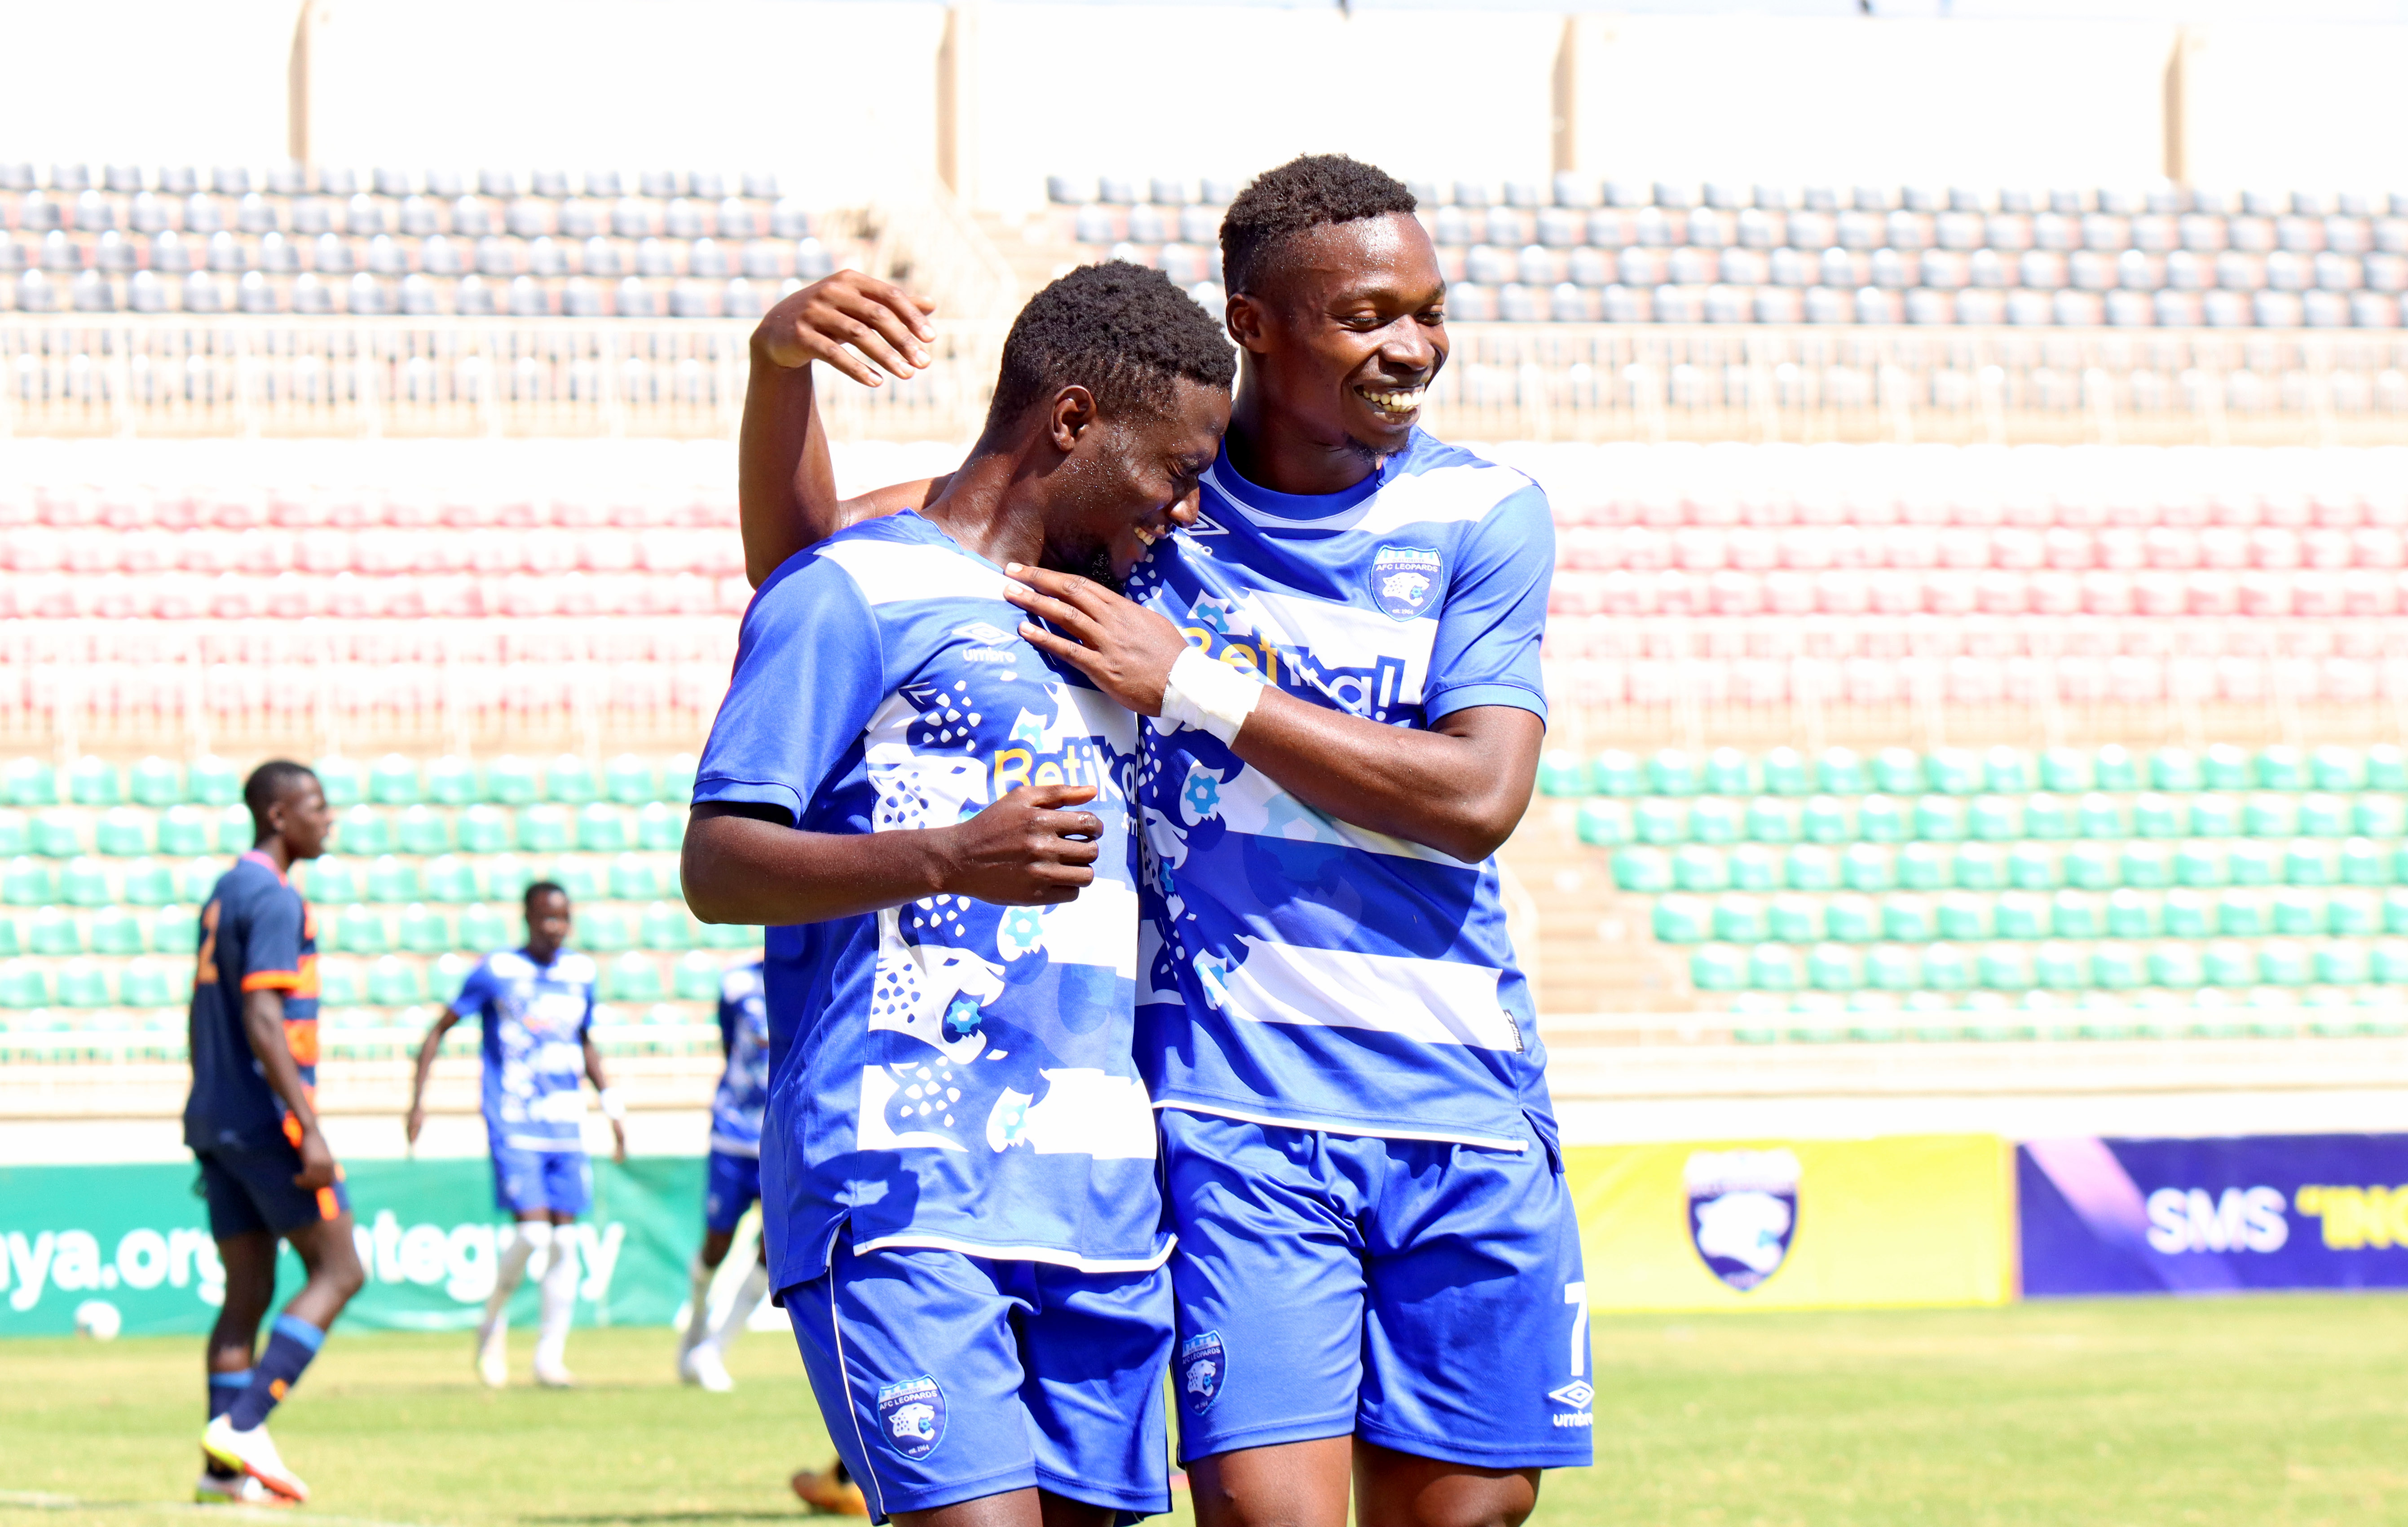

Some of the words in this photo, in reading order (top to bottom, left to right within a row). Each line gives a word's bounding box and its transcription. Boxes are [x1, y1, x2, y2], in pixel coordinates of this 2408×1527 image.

[1394, 563, 1438, 573] LEOPARDS
[962, 646, 1016, 662] umbro
[2146, 1186, 2289, 1254] SMS
[1564, 1281, 1588, 1376] 7
[1191, 1347, 1221, 1361] LEOPARDS
[879, 1401, 893, 1410] AFC
[895, 1390, 938, 1405] LEOPARDS
